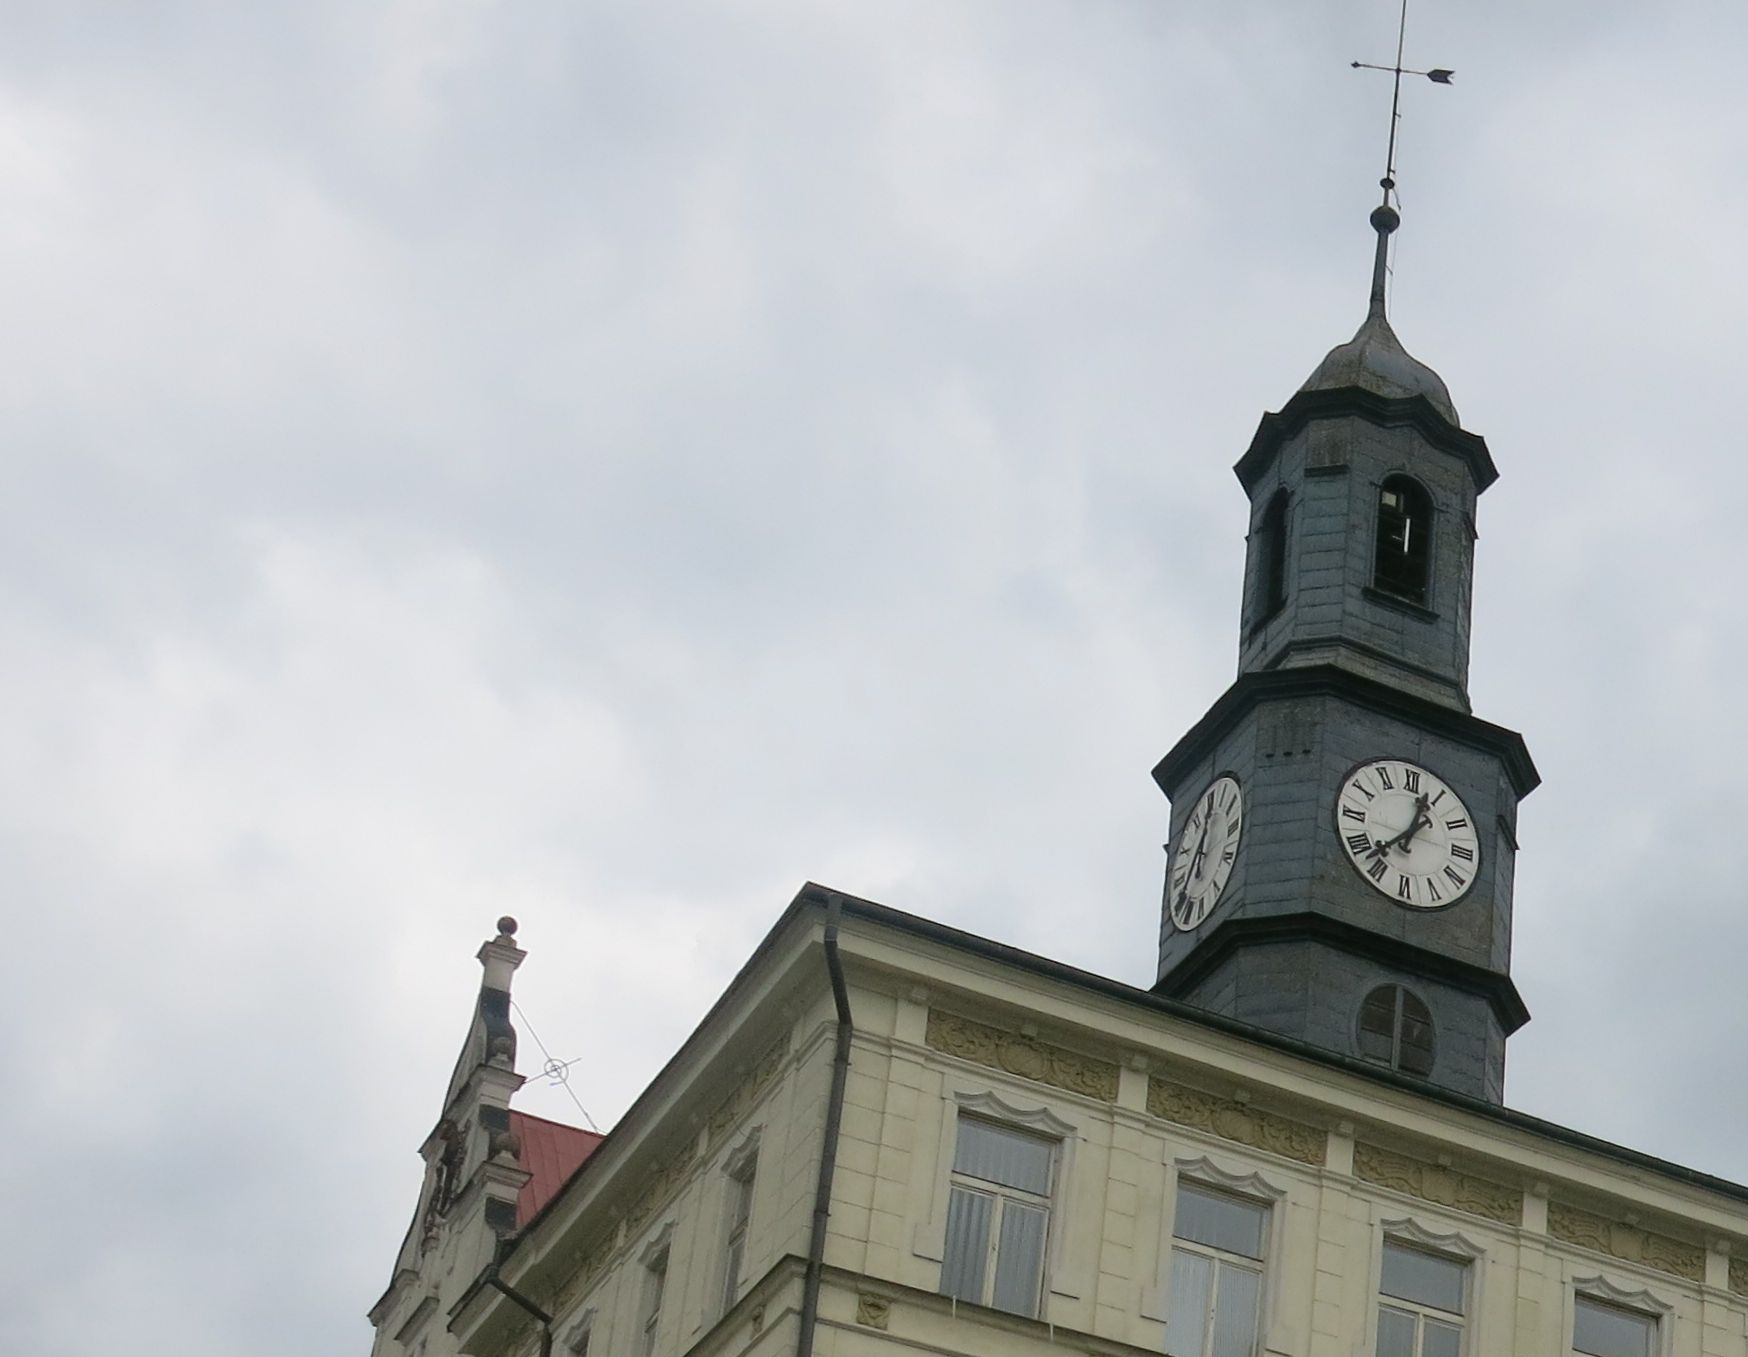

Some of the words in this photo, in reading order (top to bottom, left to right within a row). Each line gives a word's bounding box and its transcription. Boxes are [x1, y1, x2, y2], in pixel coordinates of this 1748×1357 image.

[1352, 779, 1375, 802] X
[1376, 767, 1394, 791] XI
[1403, 768, 1421, 794] XII
[1431, 789, 1446, 806] I
[1342, 804, 1366, 823] IX
[1445, 818, 1468, 831] II
[1346, 832, 1372, 857] VIII
[1451, 843, 1473, 862] III
[1366, 857, 1389, 883] VII
[1443, 865, 1466, 890] IV
[1398, 874, 1411, 900] VI
[1427, 877, 1442, 901] V
